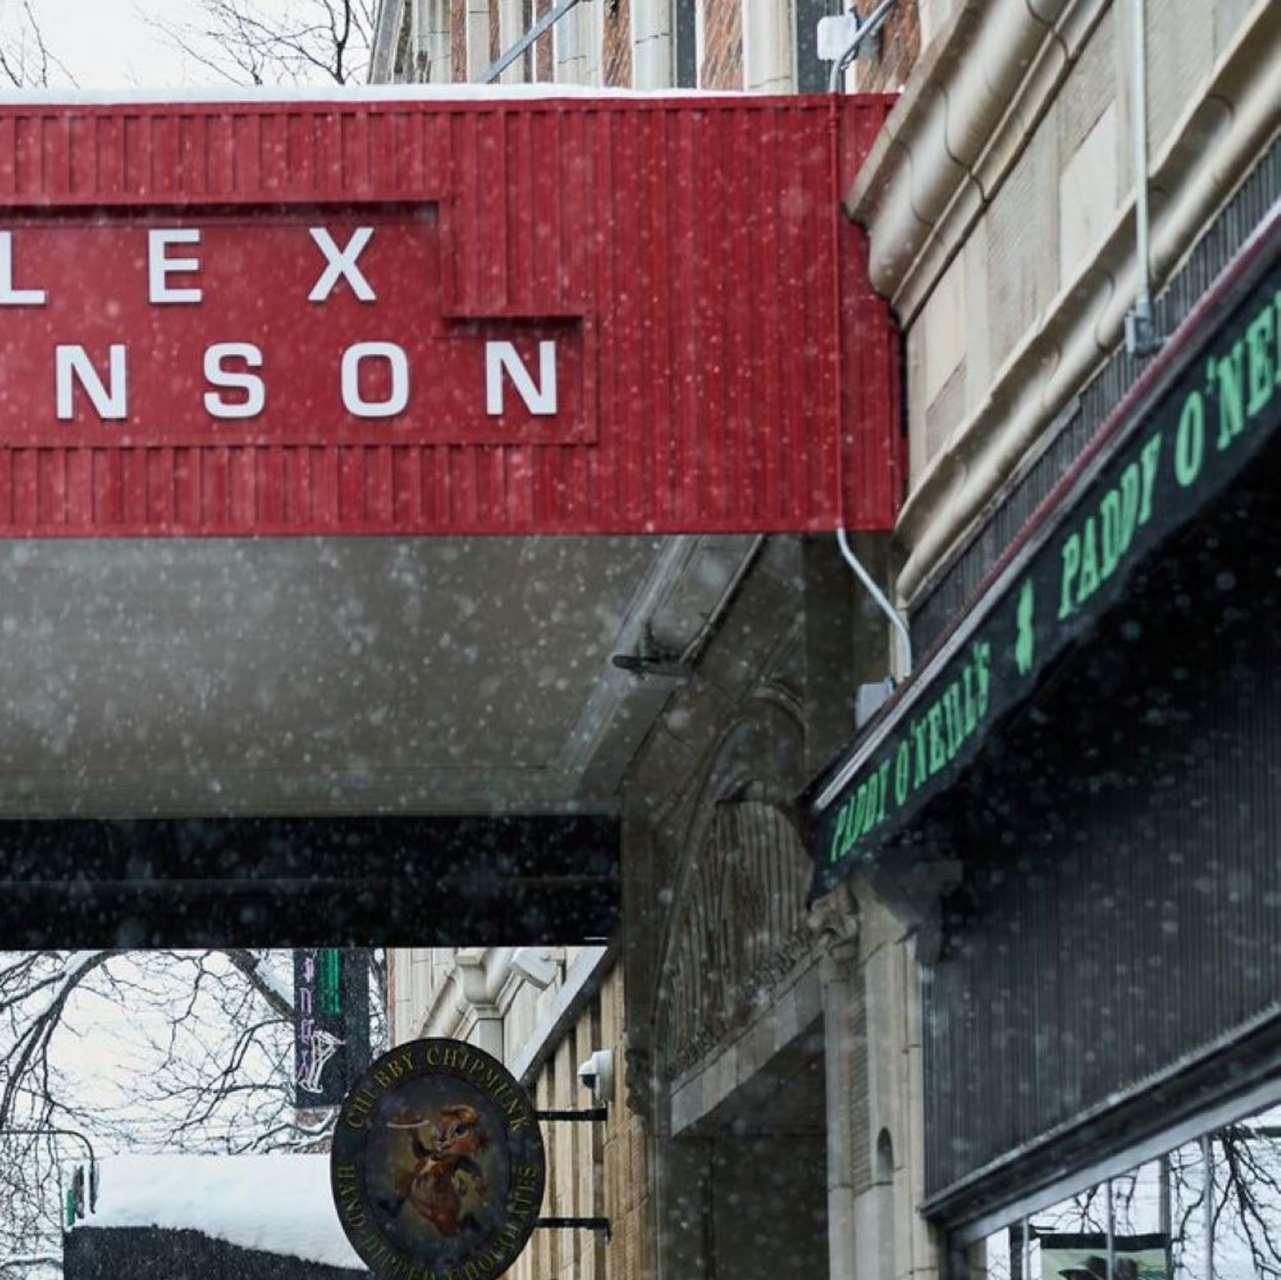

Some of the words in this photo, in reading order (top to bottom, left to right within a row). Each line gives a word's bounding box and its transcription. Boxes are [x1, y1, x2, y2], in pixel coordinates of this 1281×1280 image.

[830, 759, 891, 862] PADDY
[1058, 432, 1162, 619] PADDY
[350, 1052, 414, 1129] CHUBBY
[426, 1047, 531, 1132] CHIPMUNK
